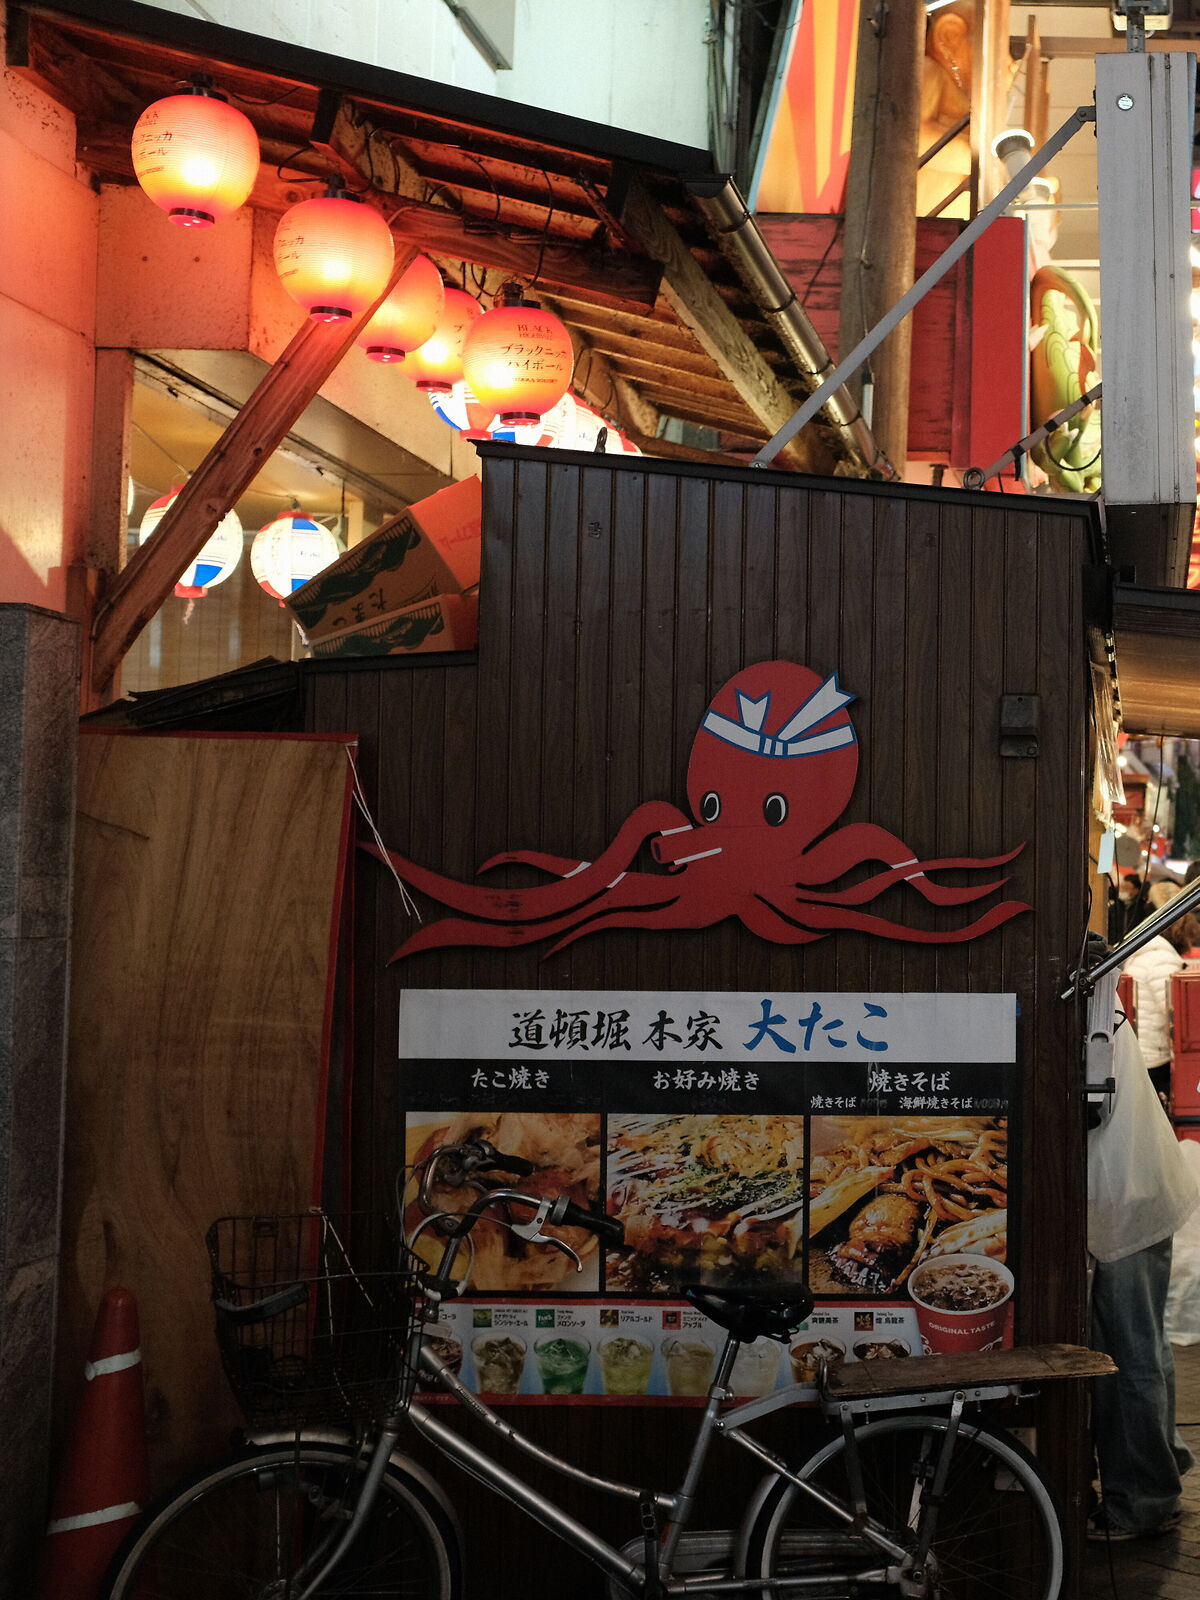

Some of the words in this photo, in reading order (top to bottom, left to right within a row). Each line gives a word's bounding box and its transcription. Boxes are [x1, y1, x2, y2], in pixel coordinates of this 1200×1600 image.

[508, 1009, 632, 1052] 道頓堀
[641, 1010, 724, 1052] 本家
[742, 999, 890, 1054] 大たこ
[470, 1067, 551, 1090] たこ焼き
[652, 1067, 761, 1092] お好み焼き
[869, 1069, 951, 1093] 焼きそば
[810, 1095, 857, 1109] 焼きそば
[899, 1095, 973, 1110] 海鮮焼きそば
[928, 1320, 969, 1336] ORIGINAL
[970, 1320, 997, 1335] TASTE
